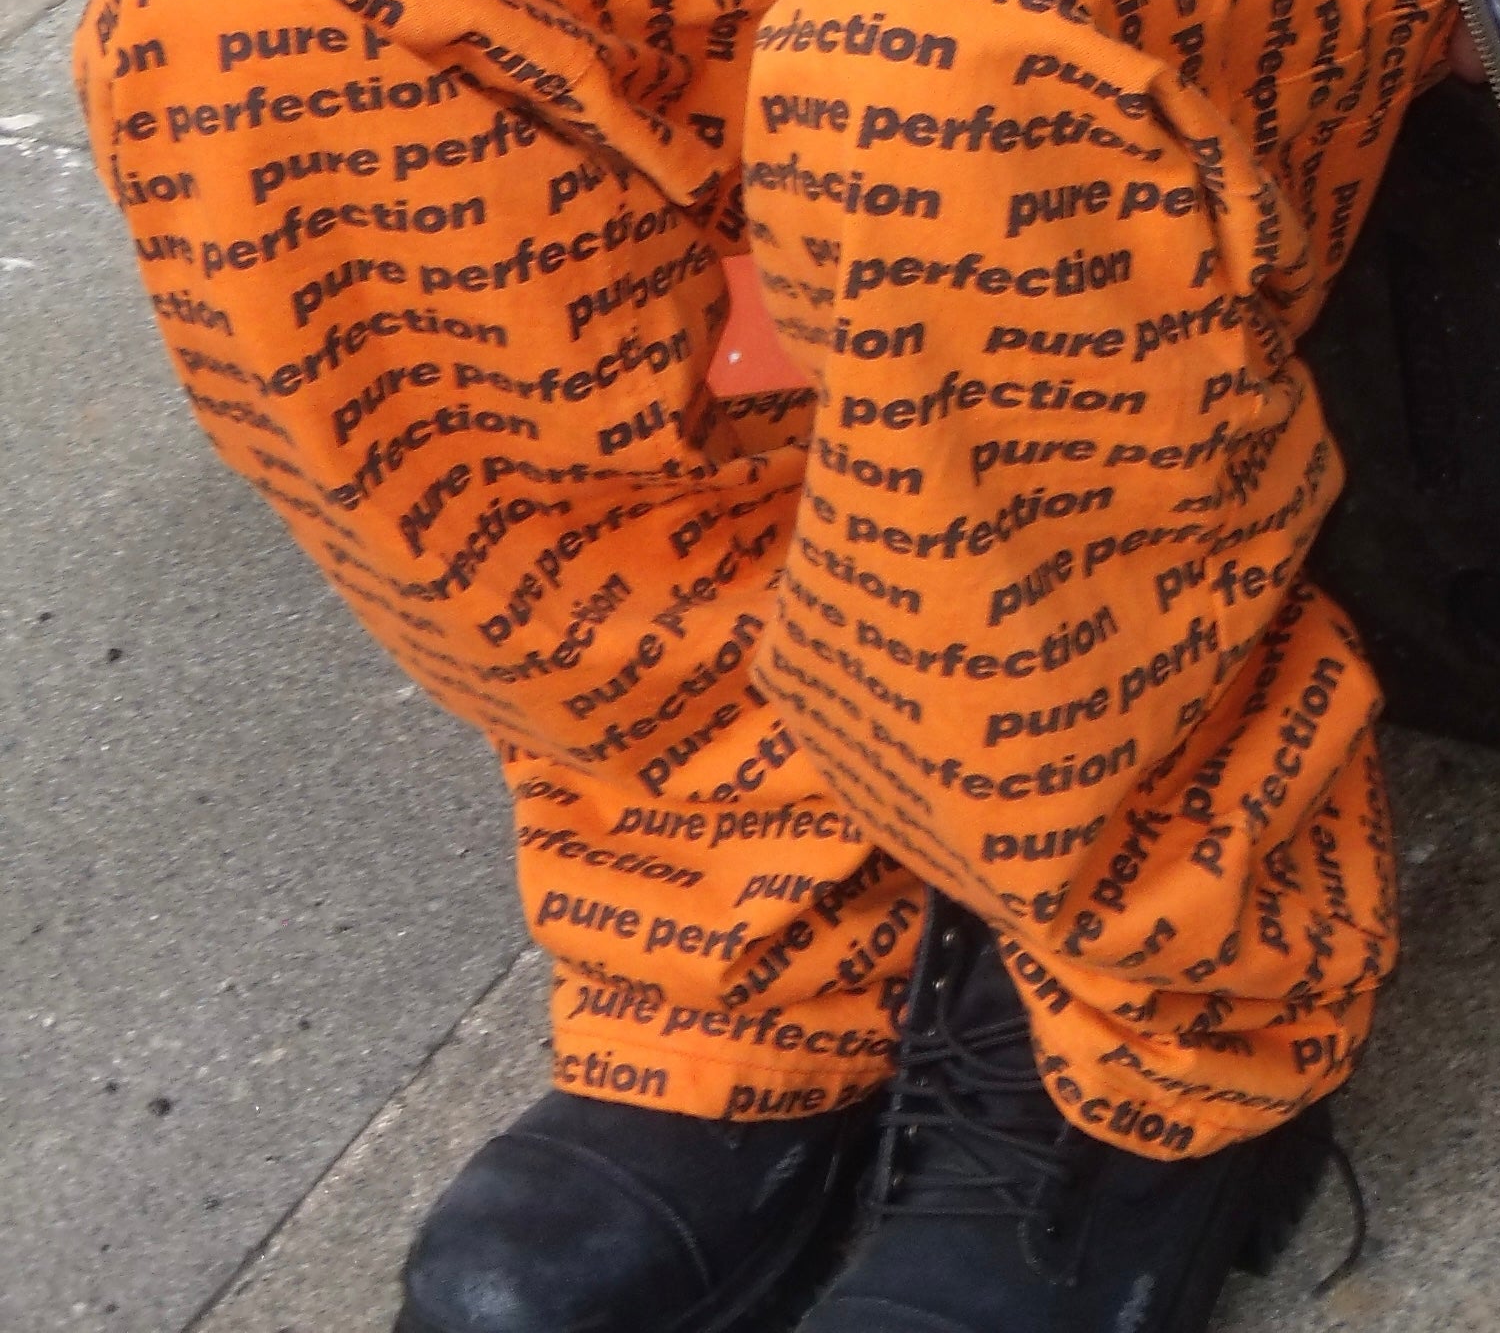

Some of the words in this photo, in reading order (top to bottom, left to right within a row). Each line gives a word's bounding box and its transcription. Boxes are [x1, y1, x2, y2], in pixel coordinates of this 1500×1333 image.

[219, 24, 349, 73] pure
[754, 10, 957, 69] erfection
[166, 64, 463, 142] perfection
[1014, 54, 1148, 120] pure
[251, 146, 380, 205] pure
[393, 109, 538, 181] perfe
[761, 94, 850, 133] pure
[857, 104, 1163, 163] perfection
[203, 197, 486, 279] perfection
[1005, 178, 1113, 238] pure
[291, 259, 406, 329] pure
[420, 203, 680, 295] perfection
[843, 249, 1131, 300] perfection
[271, 307, 509, 397] erfection
[983, 324, 1125, 359] pure
[333, 361, 441, 446] pure
[840, 371, 1147, 430] perfection
[328, 403, 539, 511] erfection
[970, 438, 1098, 485] pure
[400, 462, 472, 558] pure
[846, 487, 1115, 559] perfection
[989, 549, 1075, 626] pure
[562, 634, 665, 719] pure
[855, 605, 1118, 680] perfection
[566, 613, 764, 762] erfection
[985, 687, 1109, 747] pure
[638, 702, 742, 797] pure
[611, 806, 705, 841] pure
[536, 890, 640, 939] pure
[555, 1051, 670, 1098] ction
[724, 1083, 826, 1121] pure
